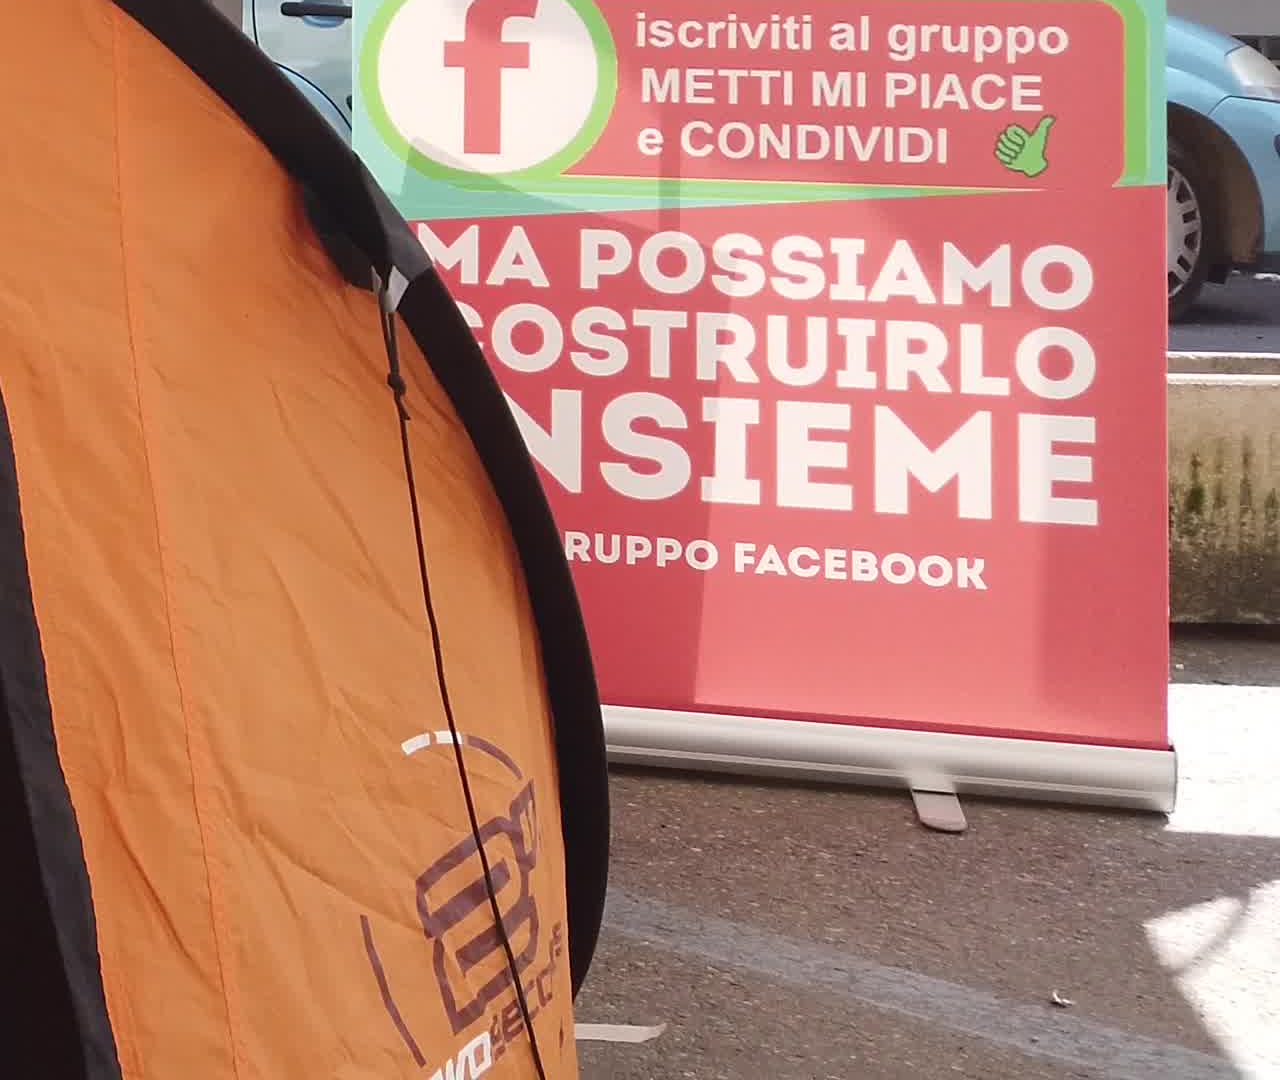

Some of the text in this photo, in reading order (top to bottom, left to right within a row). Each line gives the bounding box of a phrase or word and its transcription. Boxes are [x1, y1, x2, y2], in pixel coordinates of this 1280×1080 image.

[636, 12, 1069, 63] iscriviti al gruppo
[640, 66, 1044, 112] METTI MI PIACE
[638, 120, 948, 165] e CONDIVIDI
[417, 222, 1095, 311] MA POSSIAMO
[501, 388, 1099, 527] NSIEME
[564, 530, 987, 591] RUPPO FACEBOOK
